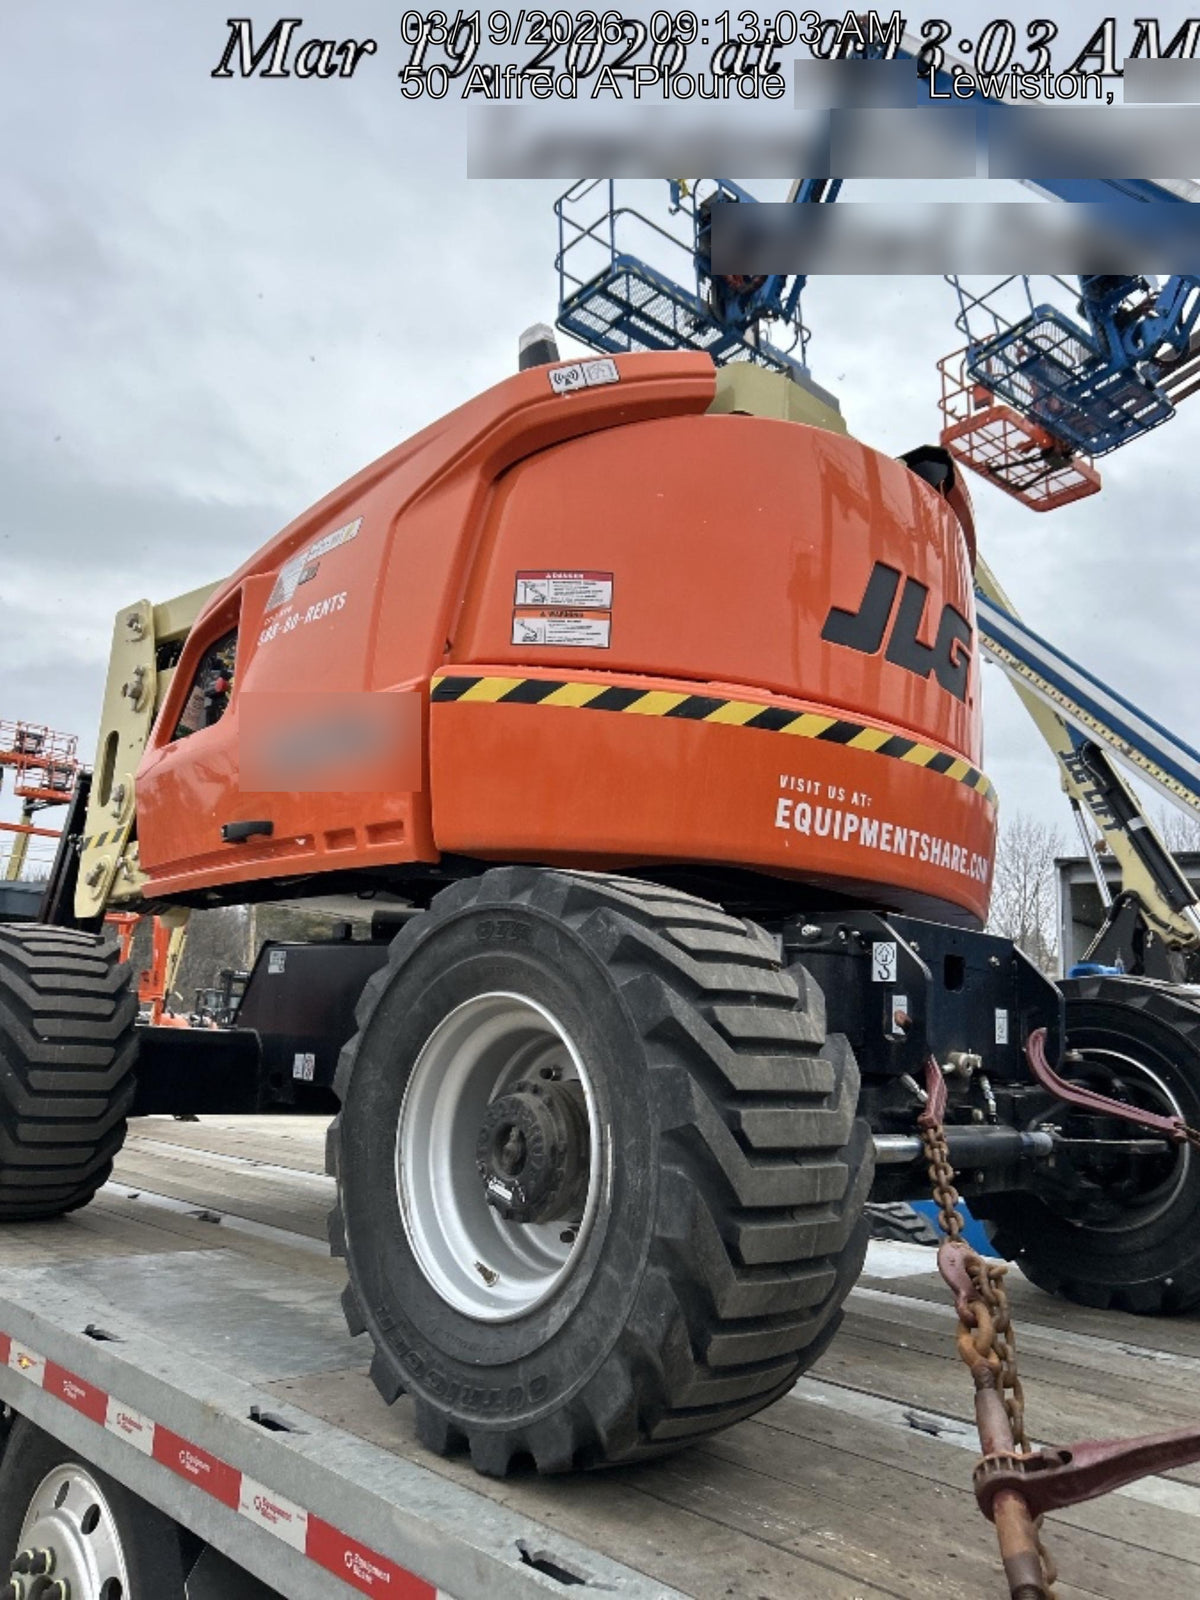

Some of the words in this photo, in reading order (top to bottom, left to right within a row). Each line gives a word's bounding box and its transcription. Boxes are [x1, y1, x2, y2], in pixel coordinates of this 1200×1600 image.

[820, 559, 973, 704] JLG
[780, 775, 821, 796] VISIT
[828, 785, 846, 801] US
[851, 792, 873, 807] AT:
[775, 797, 989, 884] EQUIPMENTSHARE.COM
